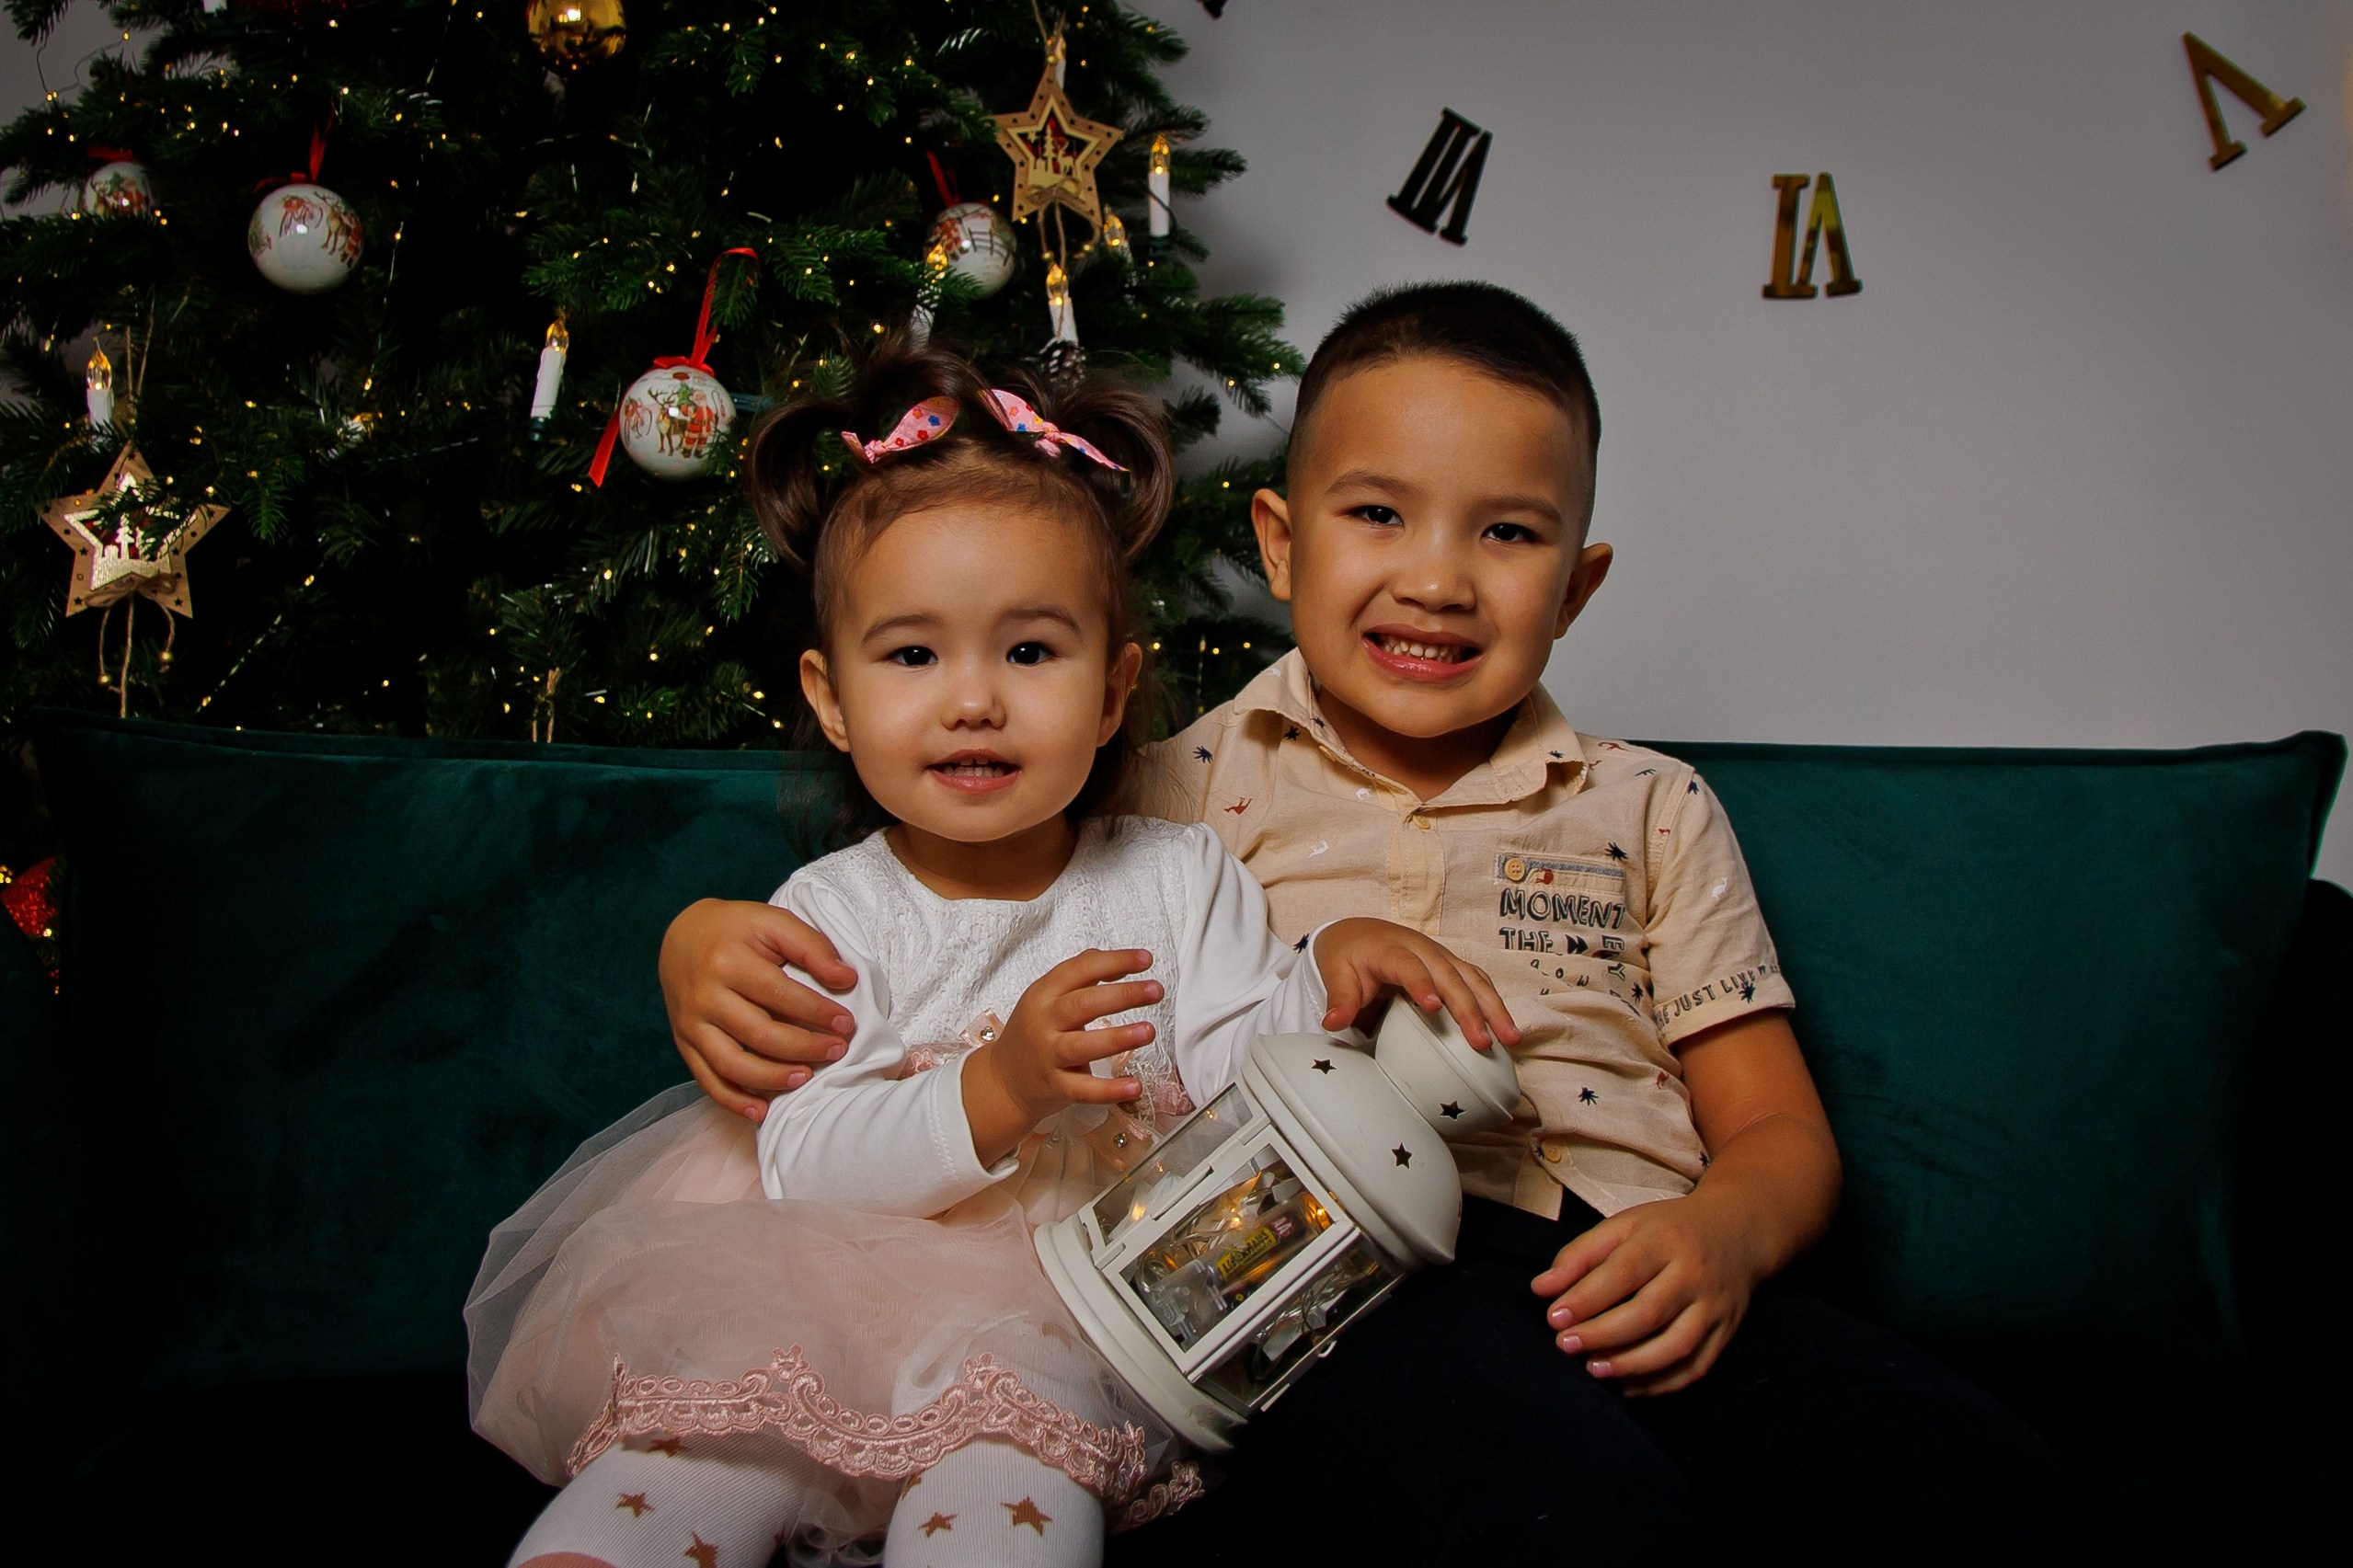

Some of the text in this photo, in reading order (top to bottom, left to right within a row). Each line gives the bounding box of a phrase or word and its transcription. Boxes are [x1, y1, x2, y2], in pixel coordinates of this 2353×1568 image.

[1499, 887, 1626, 930] MOMENT
[1498, 927, 1554, 953] THE
[1673, 984, 1716, 1019] JUST
